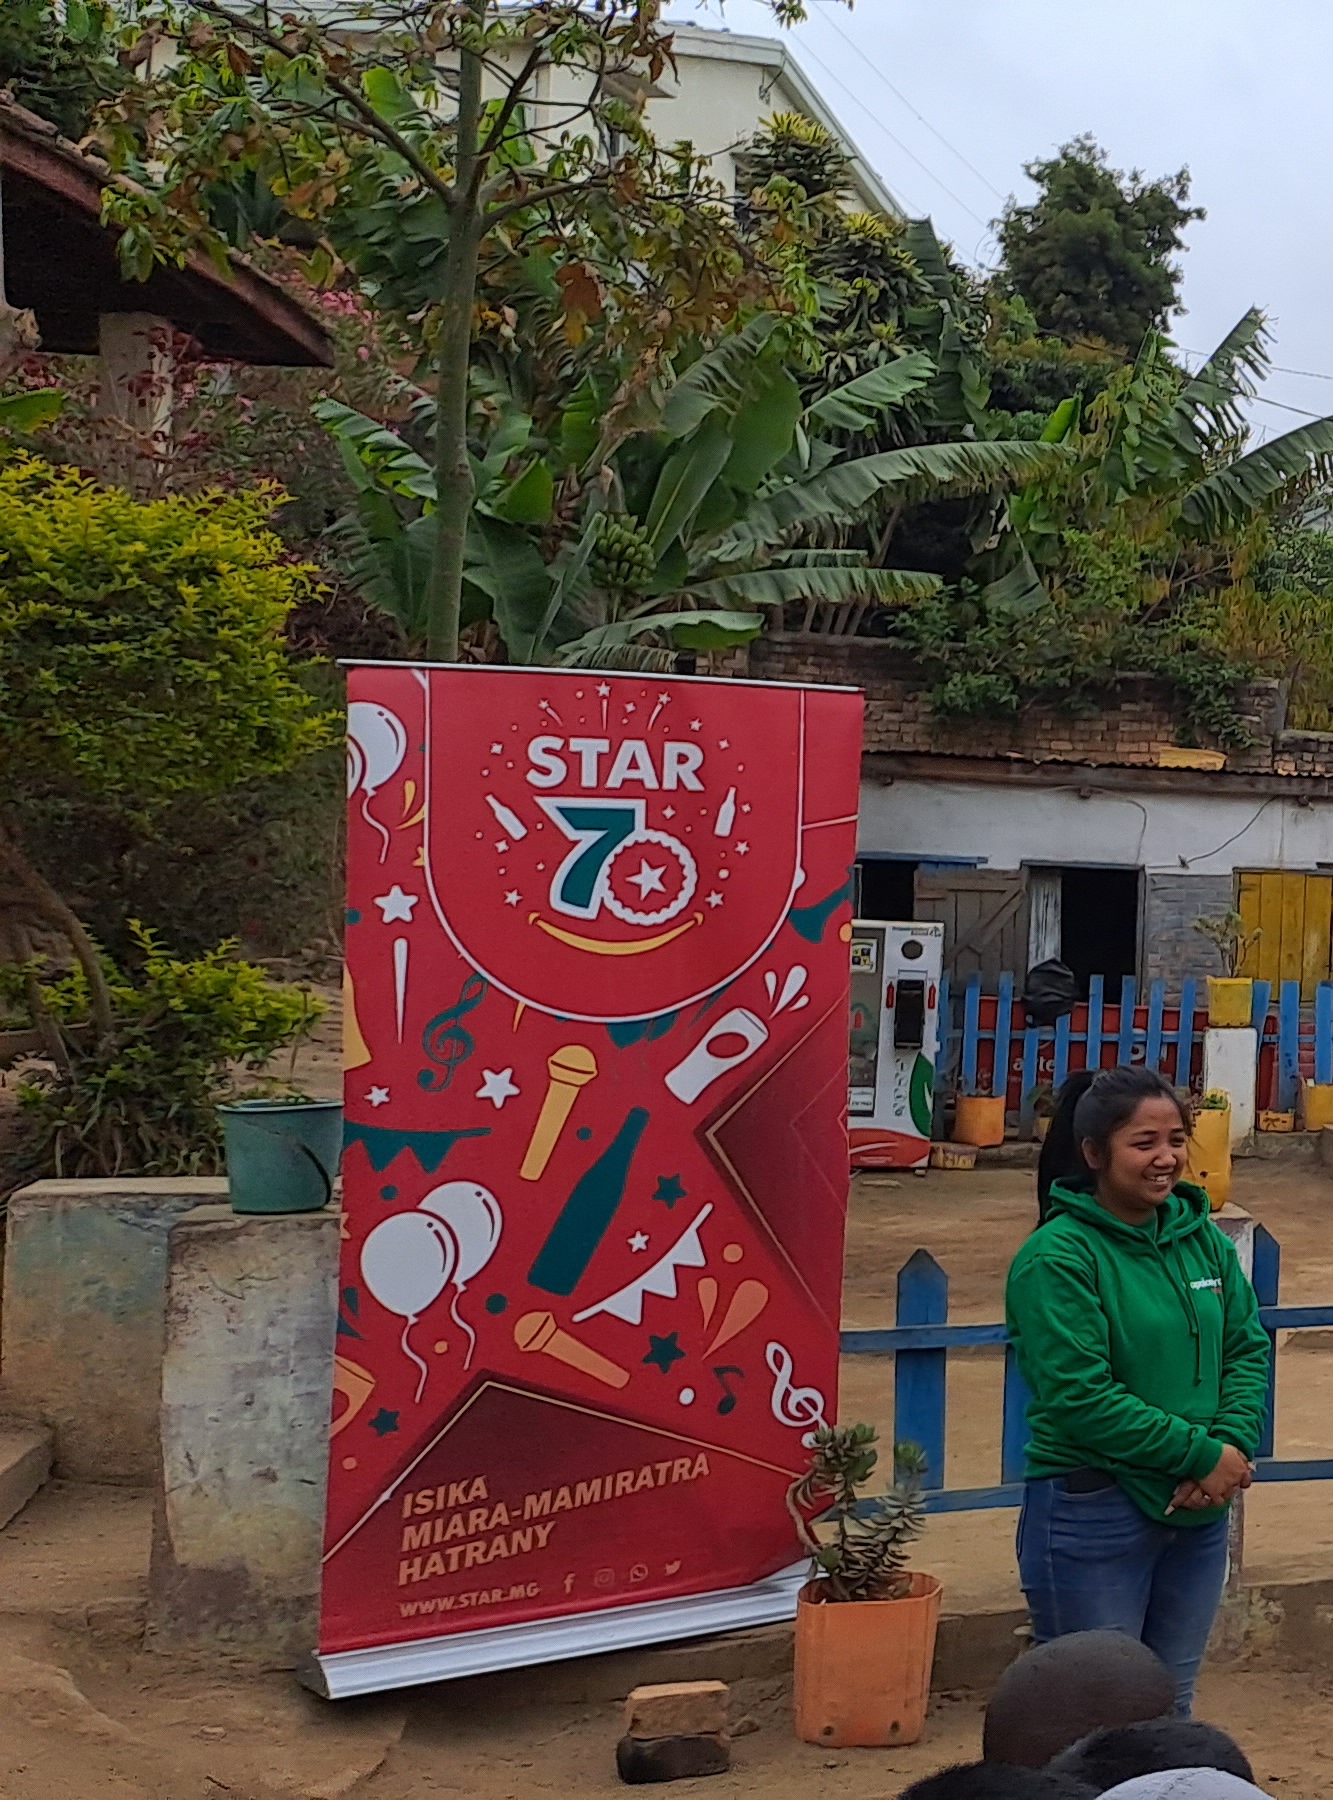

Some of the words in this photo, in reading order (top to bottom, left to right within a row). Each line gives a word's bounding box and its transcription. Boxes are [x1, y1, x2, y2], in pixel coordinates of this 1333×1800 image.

[526, 735, 704, 791] STAR
[401, 1452, 710, 1552] MIARA-MAMIRATRA
[402, 1475, 489, 1518] ISIKA
[398, 1521, 556, 1586] HATRANY
[400, 1581, 541, 1618] WWW.STAR.MG
